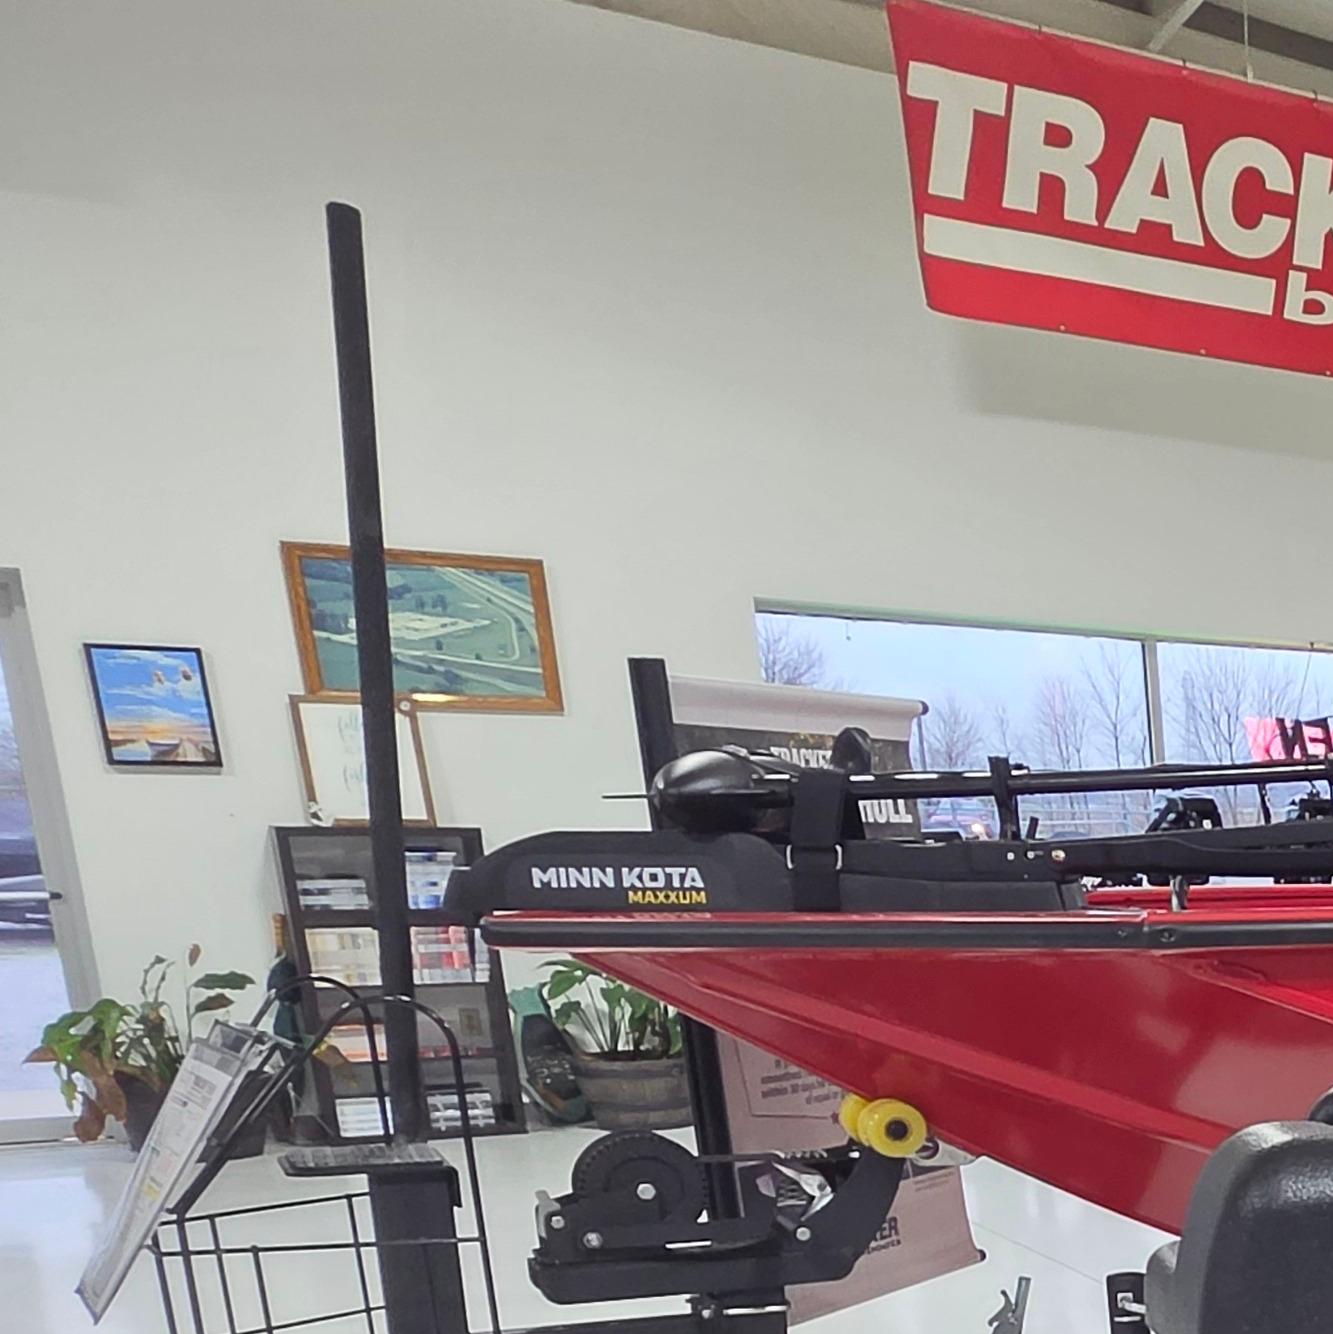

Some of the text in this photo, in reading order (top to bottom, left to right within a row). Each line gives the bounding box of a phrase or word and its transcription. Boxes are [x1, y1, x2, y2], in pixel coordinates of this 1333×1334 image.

[531, 867, 705, 889] MINN KOTA
[628, 890, 707, 904] MAXXUM
